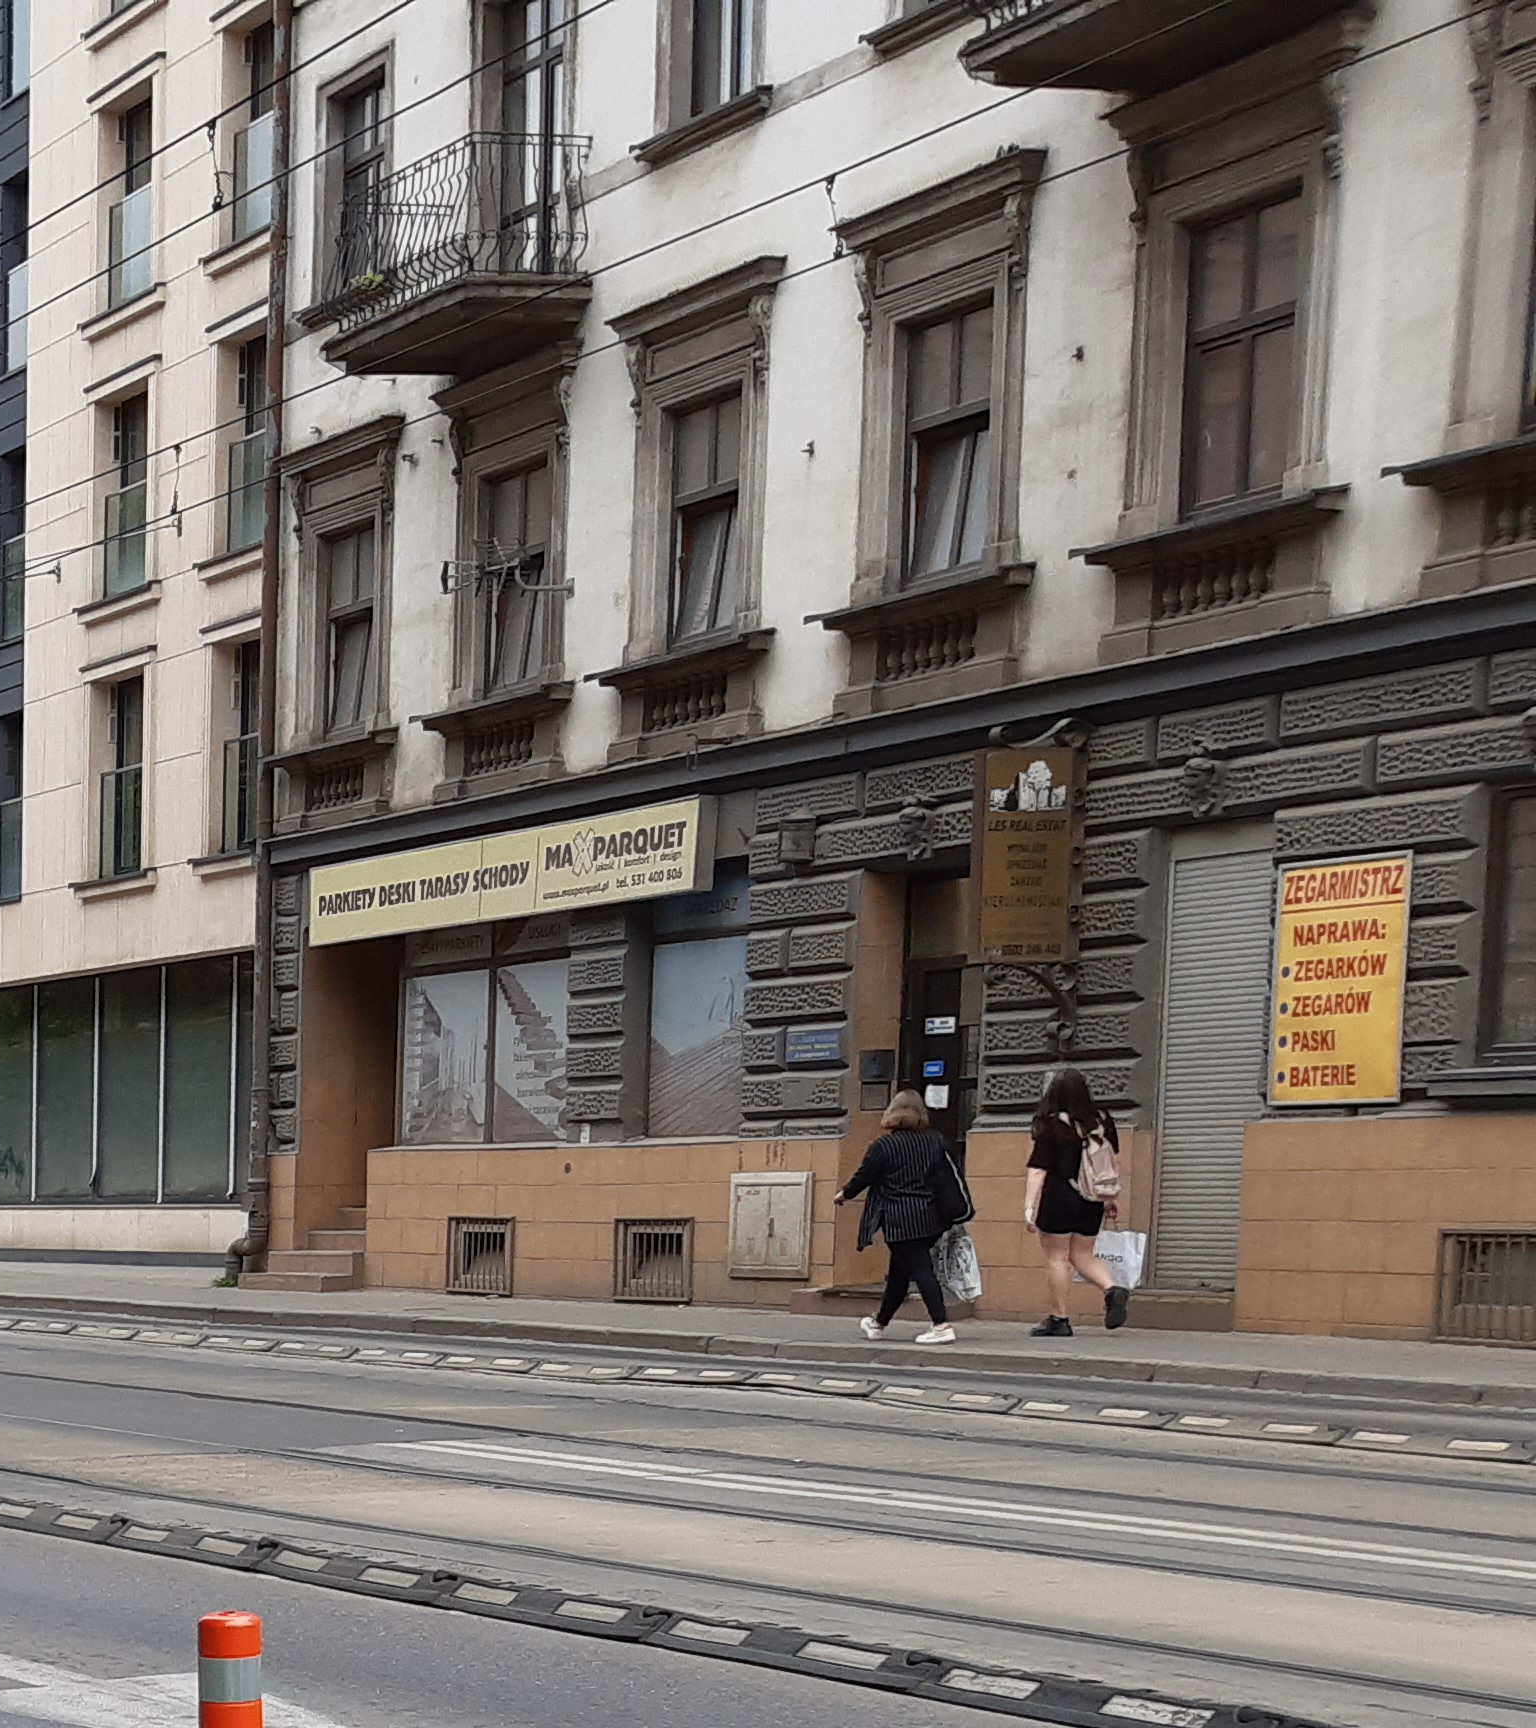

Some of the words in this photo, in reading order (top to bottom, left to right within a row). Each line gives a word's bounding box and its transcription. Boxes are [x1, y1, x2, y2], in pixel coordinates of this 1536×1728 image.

[659, 850, 683, 863] design
[318, 887, 376, 917] PARKIETY
[378, 880, 416, 907] DESKI
[419, 871, 470, 901] TARASY
[472, 860, 531, 892] SCHODY
[1283, 864, 1406, 906] ZEGARMISTRZ
[1292, 917, 1388, 948] NAPRAWA:
[1293, 948, 1389, 983] ZEGARKÓW
[1290, 986, 1373, 1018] ZEGARÓW
[1290, 1029, 1337, 1053] PASKI
[1288, 1063, 1357, 1088] BATERIE
